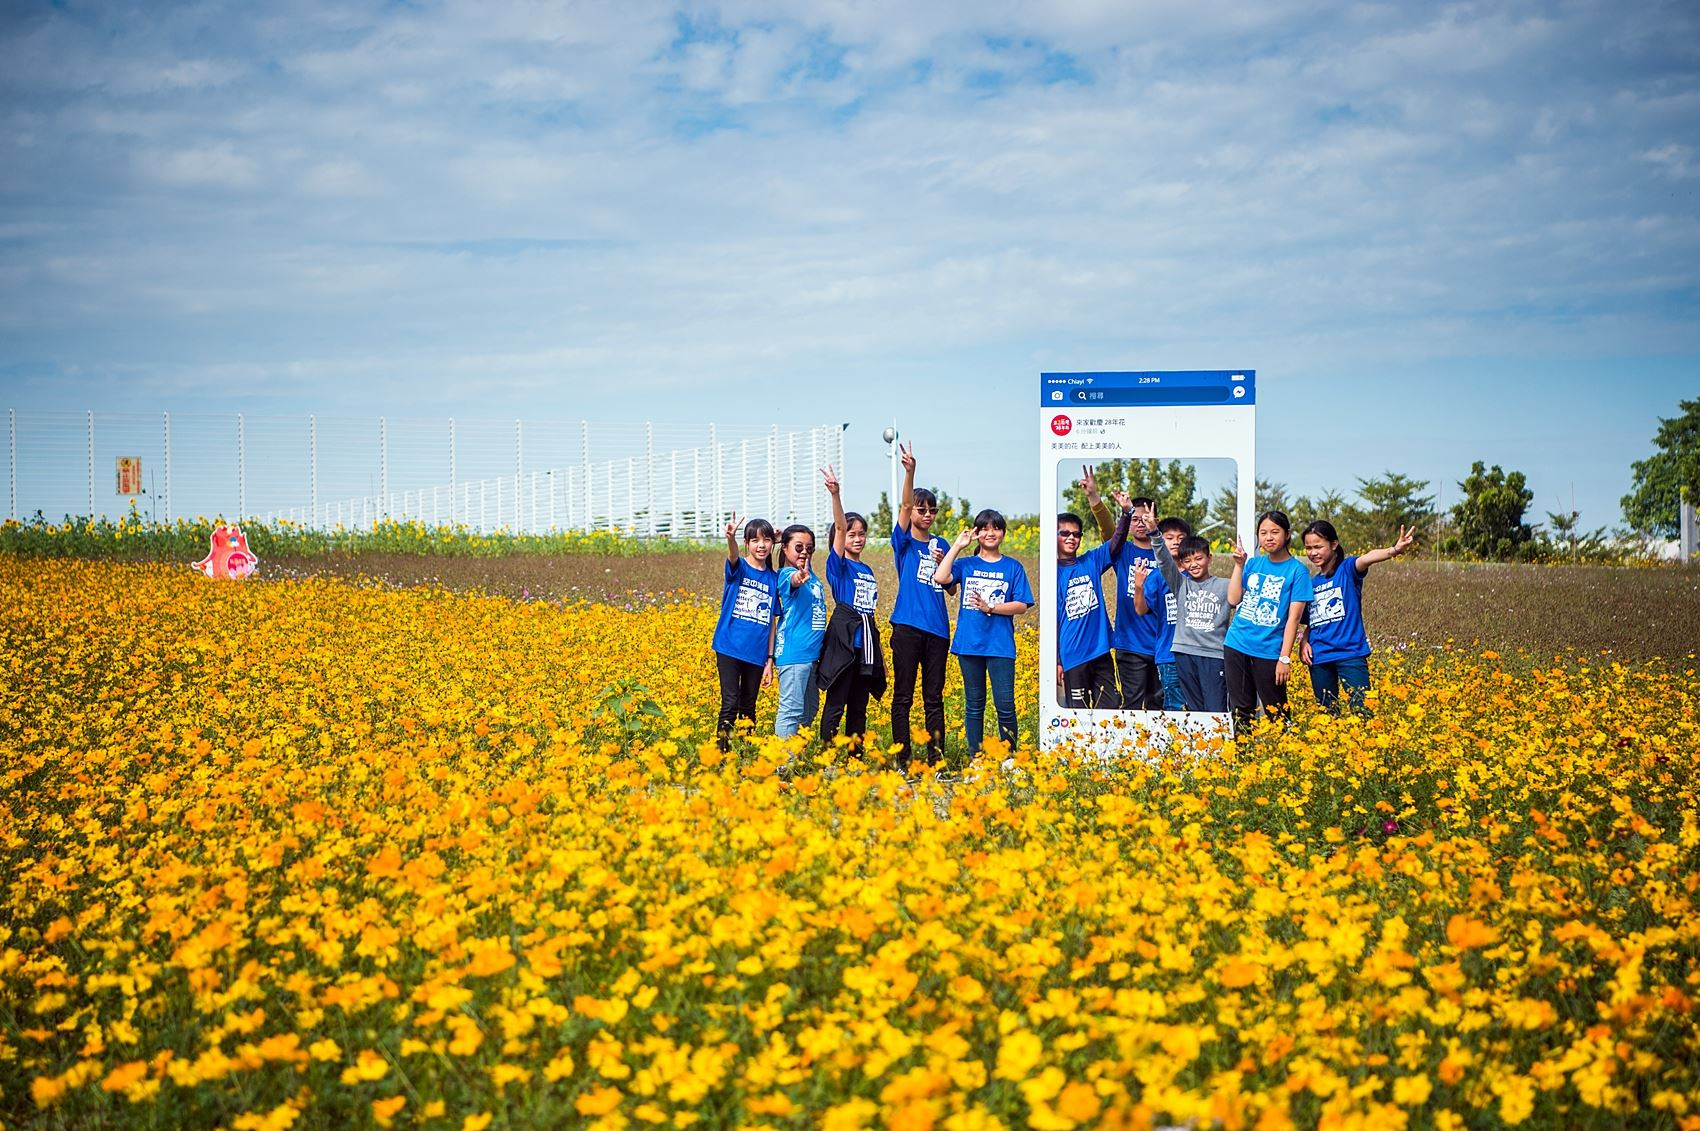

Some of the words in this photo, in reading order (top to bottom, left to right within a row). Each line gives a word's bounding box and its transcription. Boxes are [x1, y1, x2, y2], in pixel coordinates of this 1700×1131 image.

[1051, 442, 1078, 450] 美美的花
[1081, 442, 1122, 450] 配上美美的人
